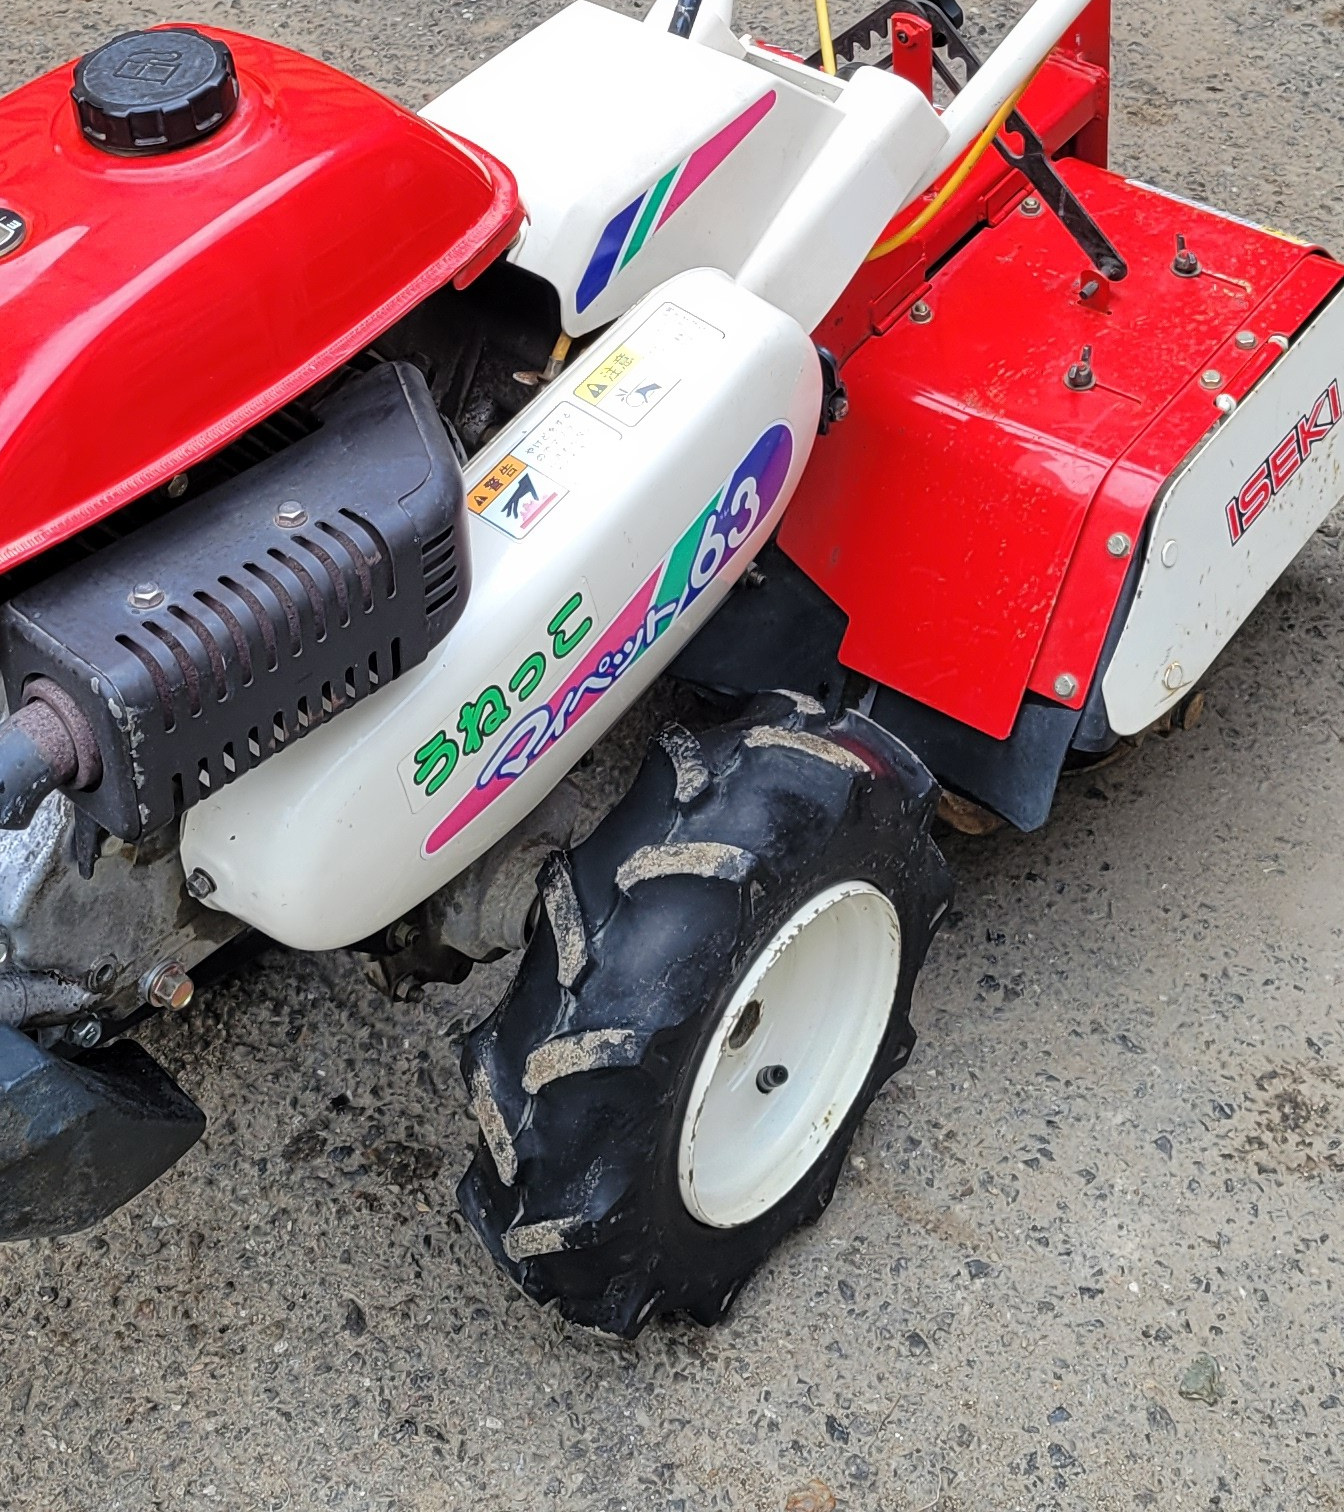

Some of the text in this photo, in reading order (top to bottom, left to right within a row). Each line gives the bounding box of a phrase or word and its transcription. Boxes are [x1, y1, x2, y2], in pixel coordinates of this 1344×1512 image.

[599, 352, 636, 382] 注意
[483, 463, 518, 492] 警告
[1225, 378, 1342, 547] ISEKI
[413, 591, 593, 796] うねっこ
